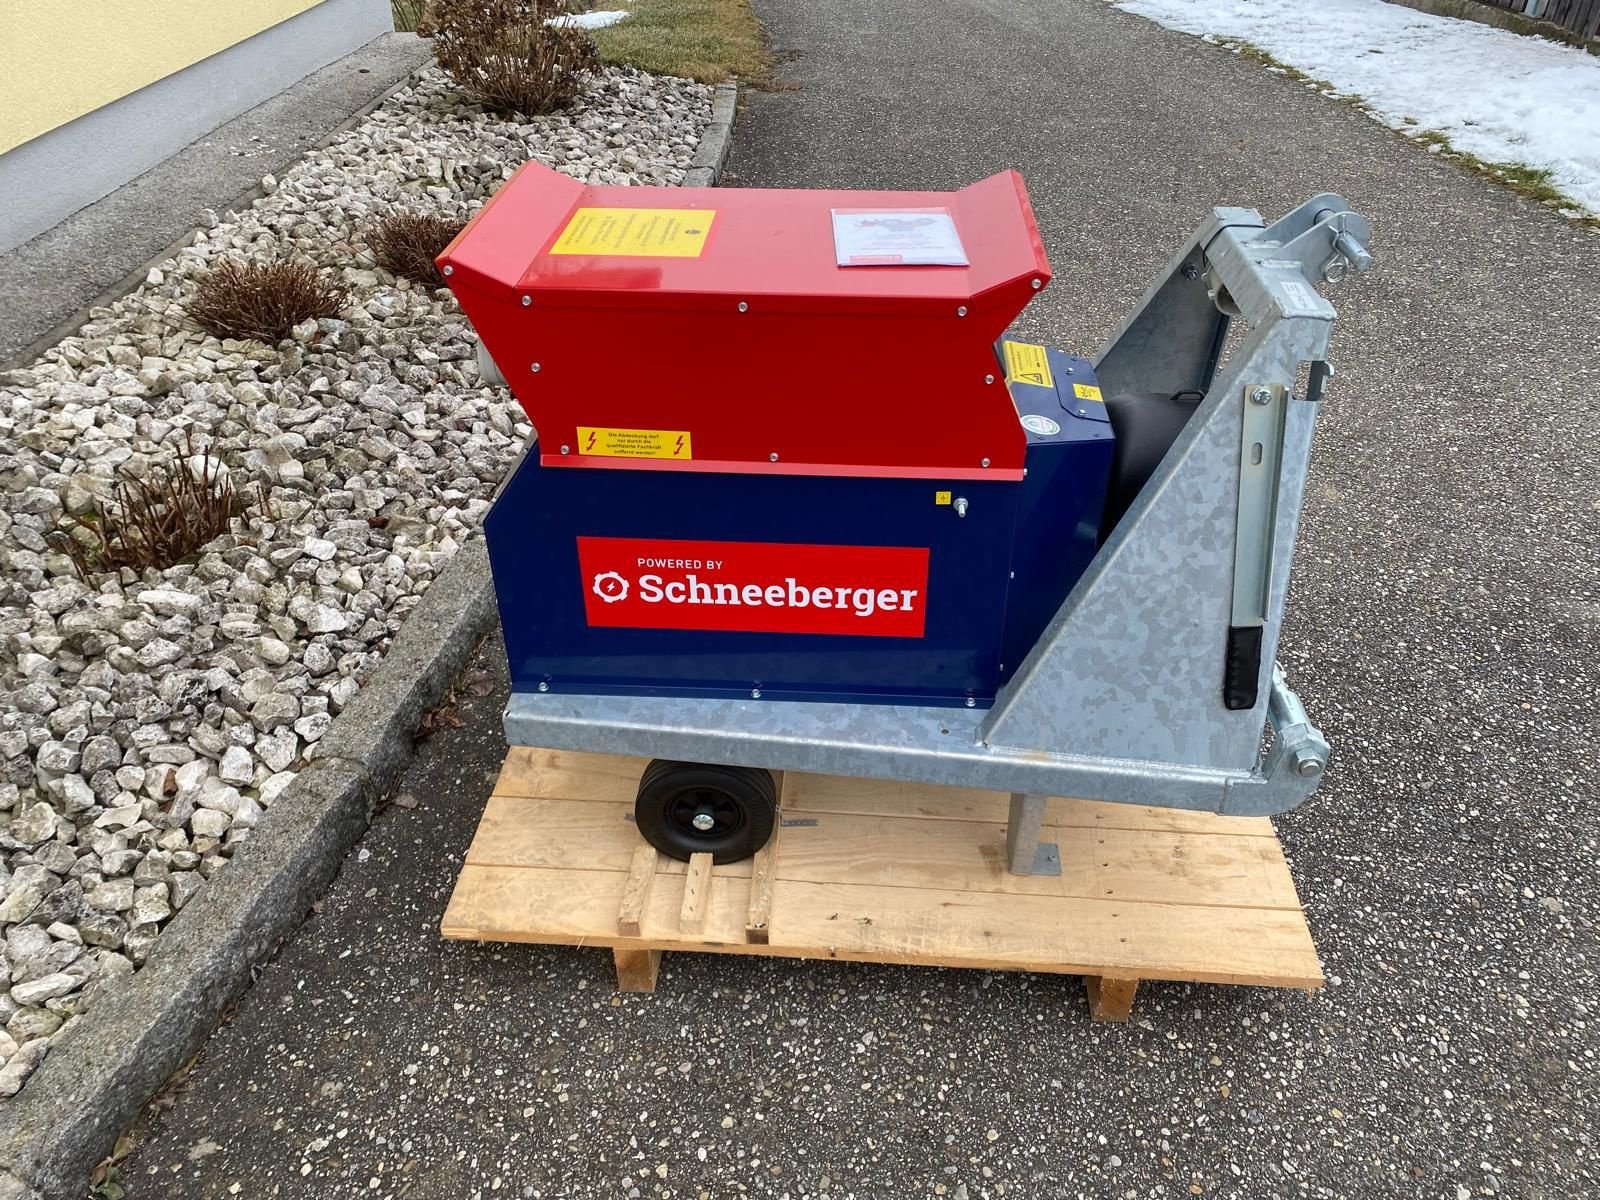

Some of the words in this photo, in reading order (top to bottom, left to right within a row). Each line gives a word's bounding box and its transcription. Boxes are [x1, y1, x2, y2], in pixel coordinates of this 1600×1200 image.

[637, 557, 702, 570] POWERED
[706, 559, 723, 570] BY
[638, 573, 918, 617] Schneeberger
